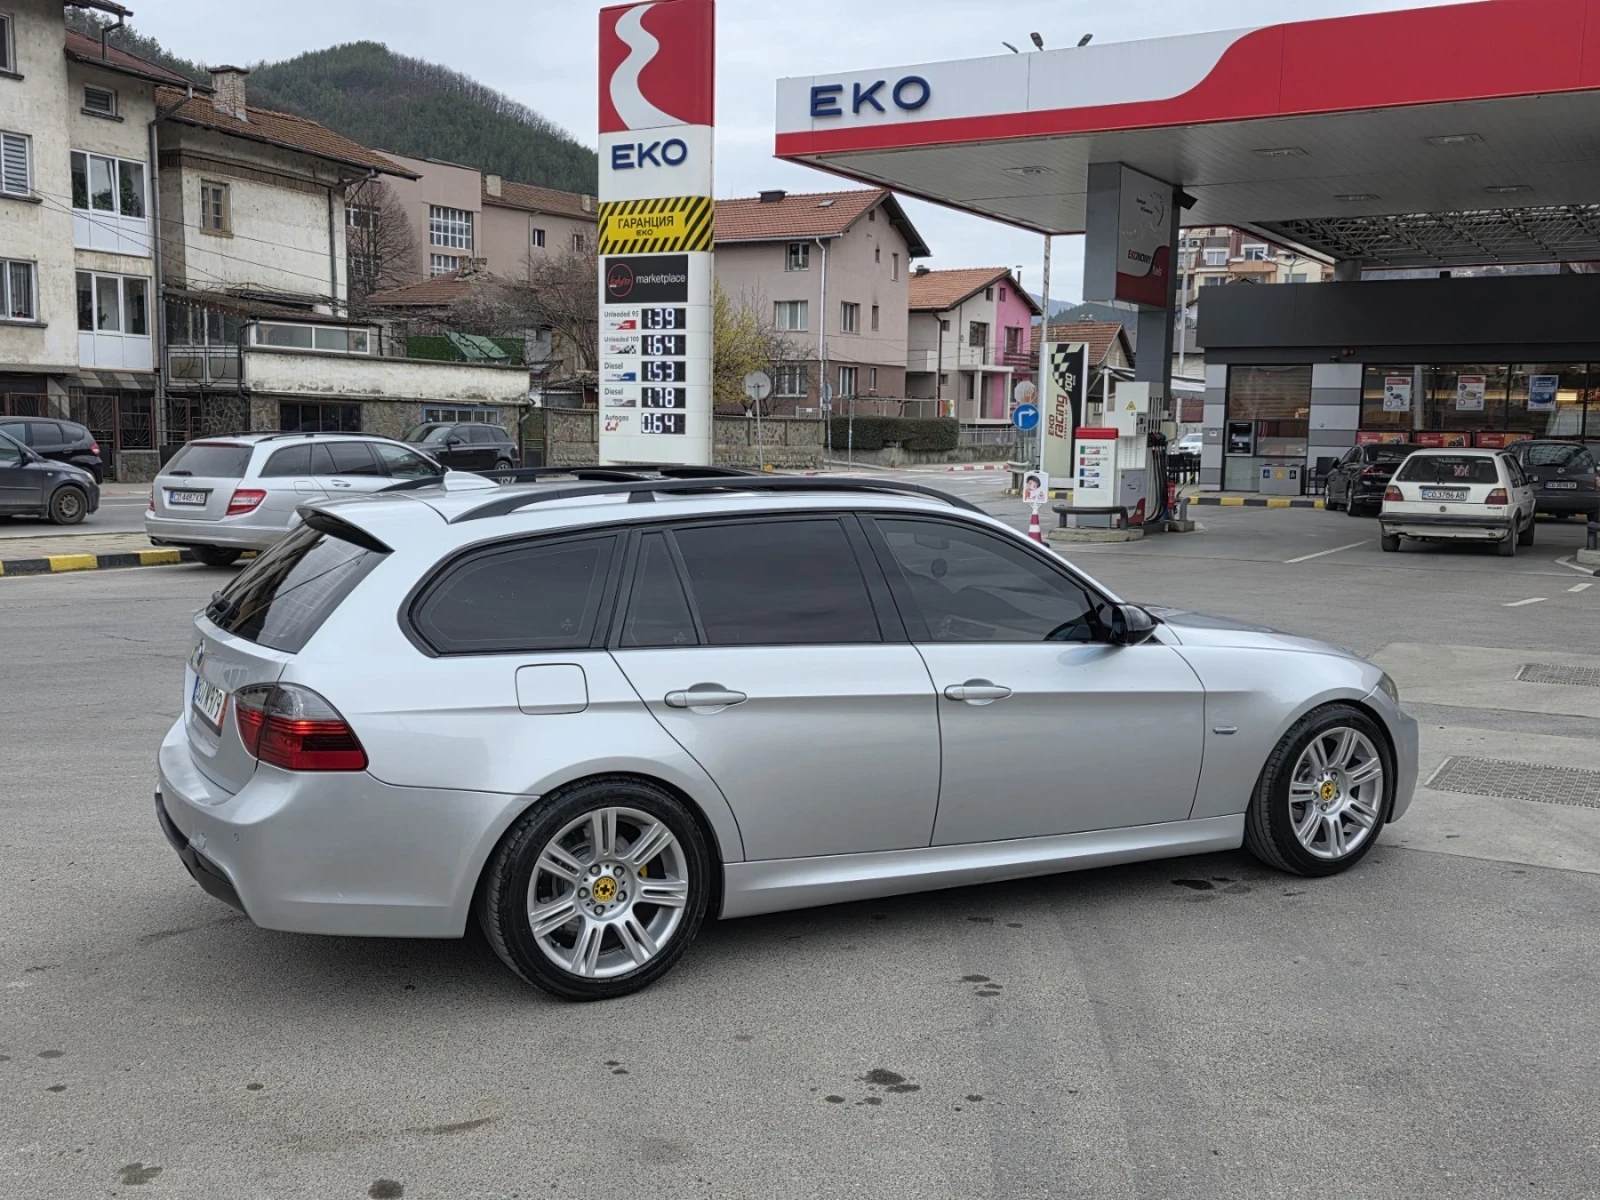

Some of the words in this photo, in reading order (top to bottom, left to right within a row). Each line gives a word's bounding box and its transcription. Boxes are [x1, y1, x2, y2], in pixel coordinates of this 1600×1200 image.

[810, 75, 931, 117] EKO
[611, 138, 688, 171] EKO
[618, 215, 674, 229] ГАРАНЦИЯ
[636, 273, 686, 285] marketplace
[604, 310, 631, 318] Unleaded
[648, 308, 675, 329] 1.39
[648, 335, 675, 355] 1.64
[648, 361, 675, 382] 1.53
[1064, 372, 1073, 392] 100
[648, 387, 675, 408] 1.78
[605, 414, 629, 422] Autogas
[641, 413, 675, 434] 0.64
[1054, 393, 1068, 438] racing
